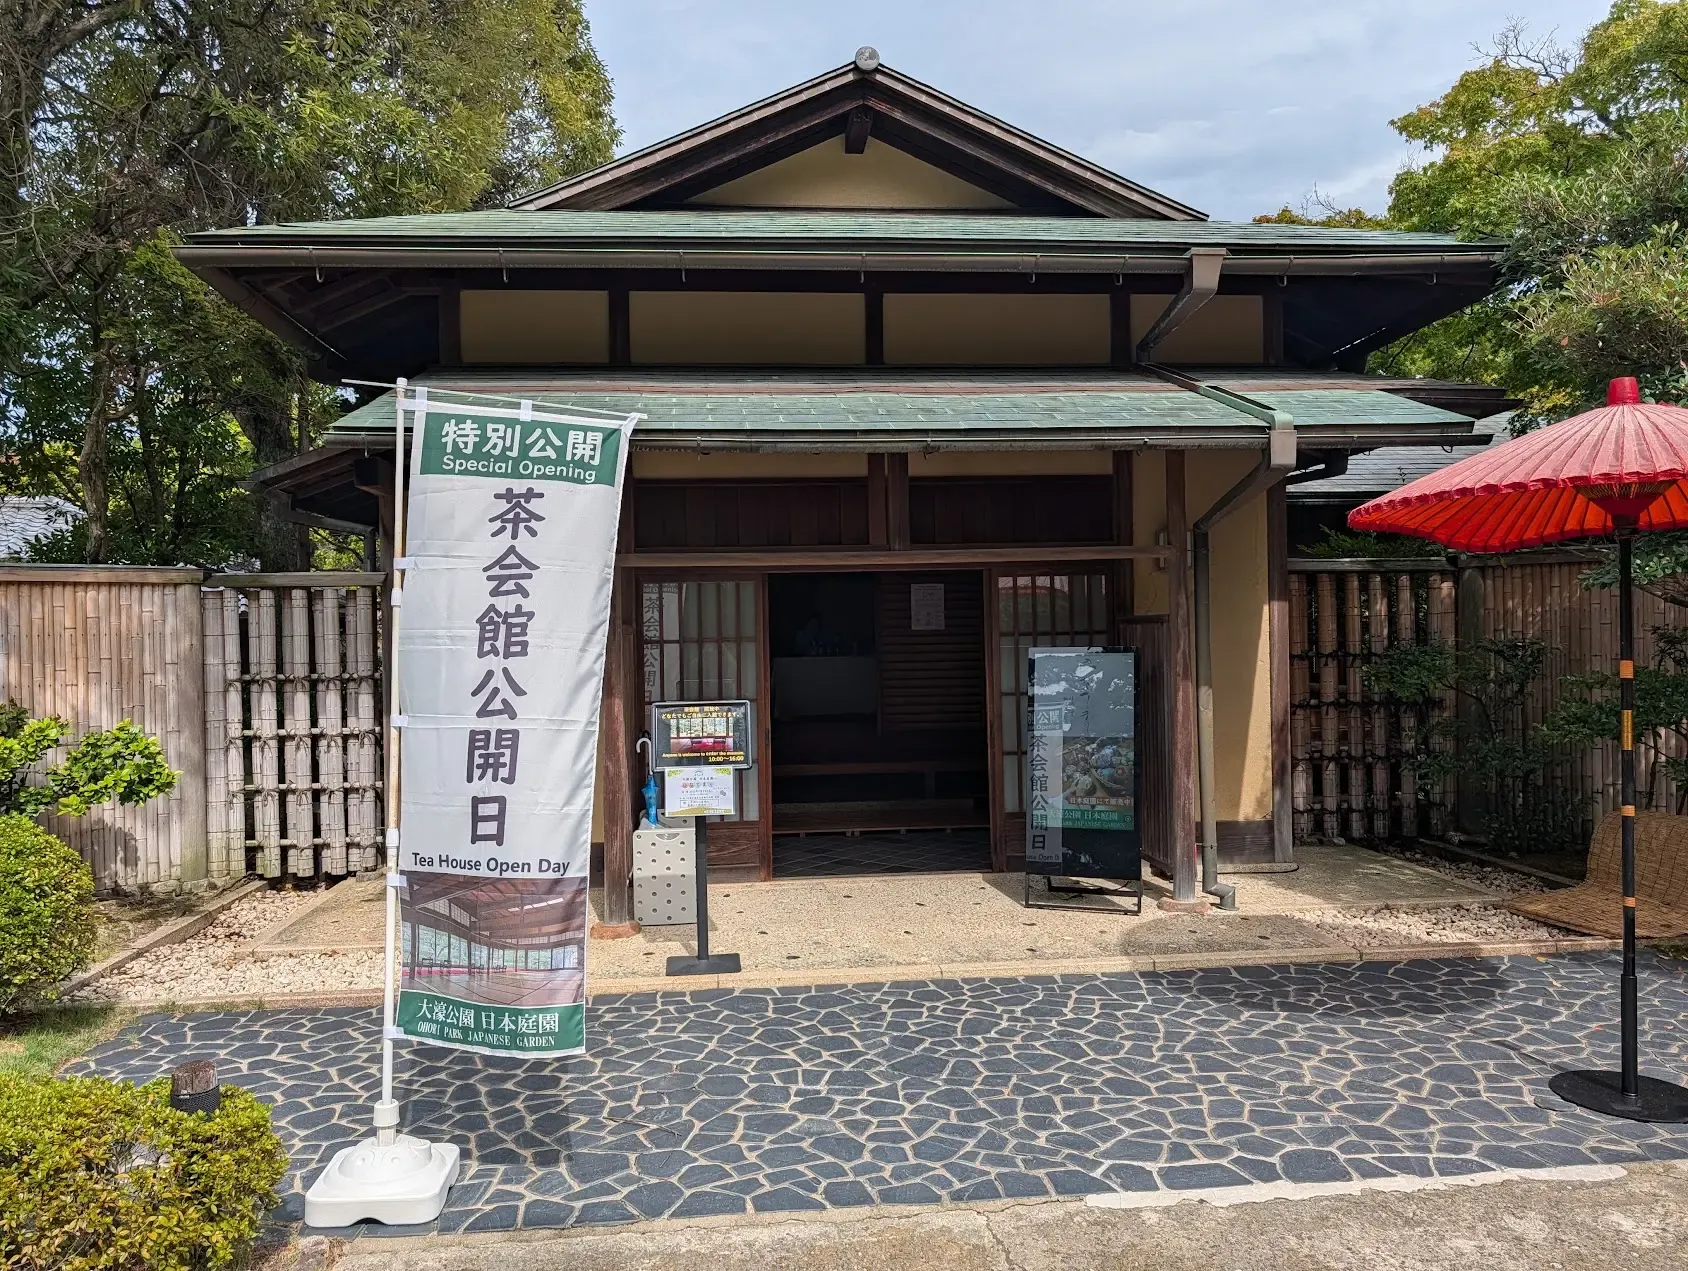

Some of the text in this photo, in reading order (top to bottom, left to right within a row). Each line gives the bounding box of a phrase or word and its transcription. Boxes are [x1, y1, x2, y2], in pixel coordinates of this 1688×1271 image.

[441, 419, 604, 466] 特別公開
[441, 454, 596, 484] Special Opening
[466, 487, 546, 847] 茶会館公開日
[411, 852, 571, 877] Tea House Open Day
[416, 998, 559, 1034] 大濠公園 日本庭園
[417, 1021, 556, 1047] OHORI PARK JAPANESE GARDEN
